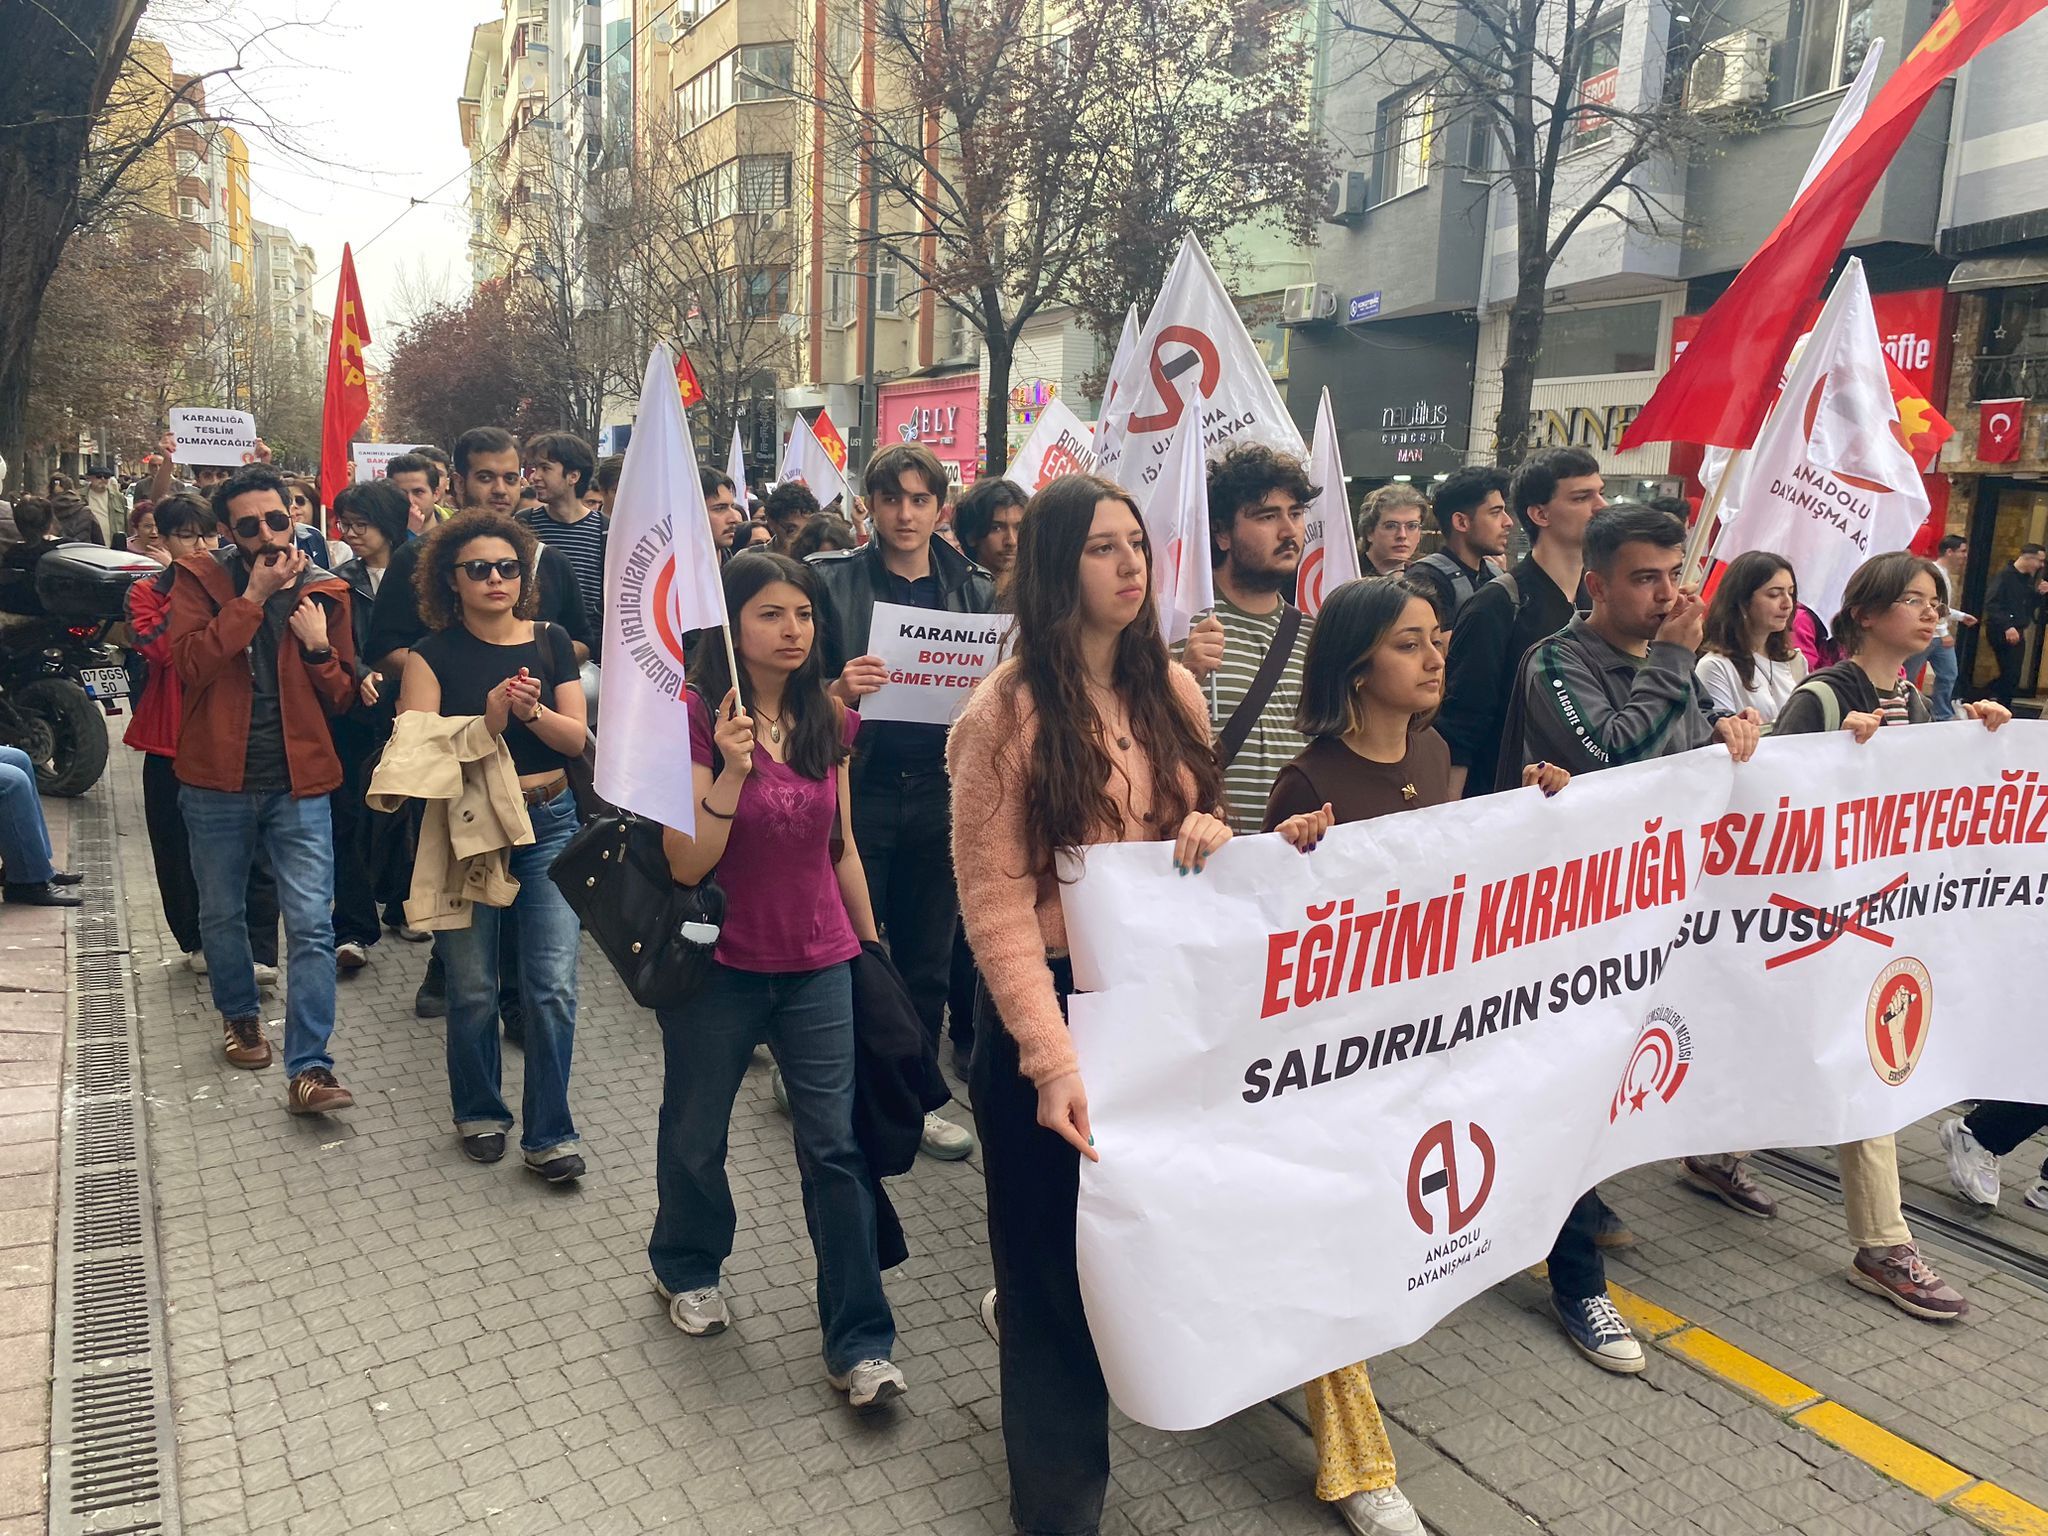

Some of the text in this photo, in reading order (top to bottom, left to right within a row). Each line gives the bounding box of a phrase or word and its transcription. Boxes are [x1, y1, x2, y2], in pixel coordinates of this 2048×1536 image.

[1880, 333, 1931, 370] öfte
[182, 414, 244, 424] KARANLIĞA
[195, 426, 234, 435] TESLİM
[1382, 400, 1448, 427] nautilus
[1490, 404, 1644, 450] ENNE
[1397, 448, 1423, 462] MAN
[1770, 479, 1847, 533] DAYANIŞMA
[1792, 463, 1872, 520] ANADOLU
[82, 668, 124, 682] 07 GGS
[918, 650, 984, 667] BOYUN
[101, 681, 117, 693] 50
[888, 669, 981, 688] ĞMEYECE
[1556, 689, 1581, 726] LACOSTE
[1260, 873, 1467, 1020] EĞİTİMİ
[1472, 816, 1687, 964] KARANLIĞA
[1834, 769, 2048, 870] ETMEYECEĞİZ
[1242, 981, 1542, 1104] SALDIRILARIN
[1731, 900, 1852, 944] YUSUF
[1856, 875, 1931, 931] TEKİN
[1932, 867, 2048, 914] İSTİFA!
[1425, 1227, 1481, 1264] ANADOLU
[1408, 1239, 1493, 1292] DAYANIŞMA AĞI
